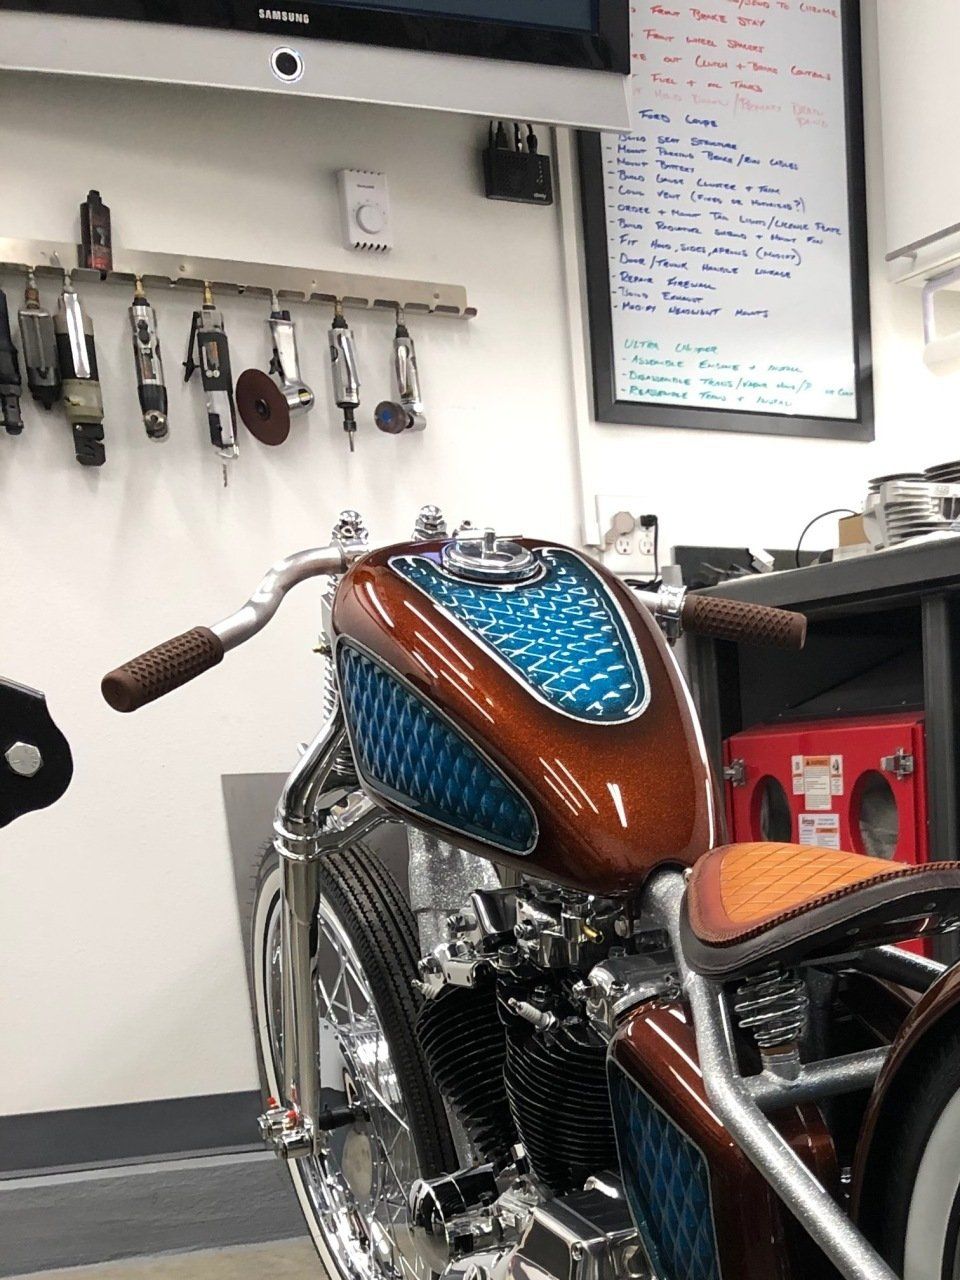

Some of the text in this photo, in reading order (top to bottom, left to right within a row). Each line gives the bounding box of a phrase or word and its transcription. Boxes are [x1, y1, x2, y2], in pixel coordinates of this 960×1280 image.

[258, 8, 310, 24] SAMSUNG
[650, 5, 680, 17] FRONT
[690, 8, 727, 24] BRAKE
[737, 16, 765, 27] STAY
[643, 29, 674, 42] FRONT
[686, 36, 717, 48] WHEEL
[663, 56, 682, 64] OUT
[695, 55, 728, 69] CLUTCH
[748, 61, 778, 75] BRAKE
[651, 73, 677, 85] FUEL
[730, 80, 763, 93] TANKS
[638, 109, 718, 127] FORD COUPE
[658, 136, 680, 144] SEAT
[691, 137, 737, 150] STRUCTURE
[617, 144, 647, 154] MOUNT
[658, 147, 695, 159] PARKING
[617, 158, 695, 173] MOUNT BATTERY
[617, 170, 645, 182] BUILD
[697, 178, 736, 191] CLUSTER
[657, 191, 681, 200] VENT
[617, 203, 650, 214] ORDER
[671, 209, 701, 218] MOUNT
[617, 218, 643, 230] BUILD
[619, 233, 638, 246] FIT
[702, 264, 739, 275] HANDLE
[619, 271, 717, 290] REPAIR FIREWALL
[661, 291, 703, 304] EXHAUST
[624, 338, 660, 351] ULTRA
